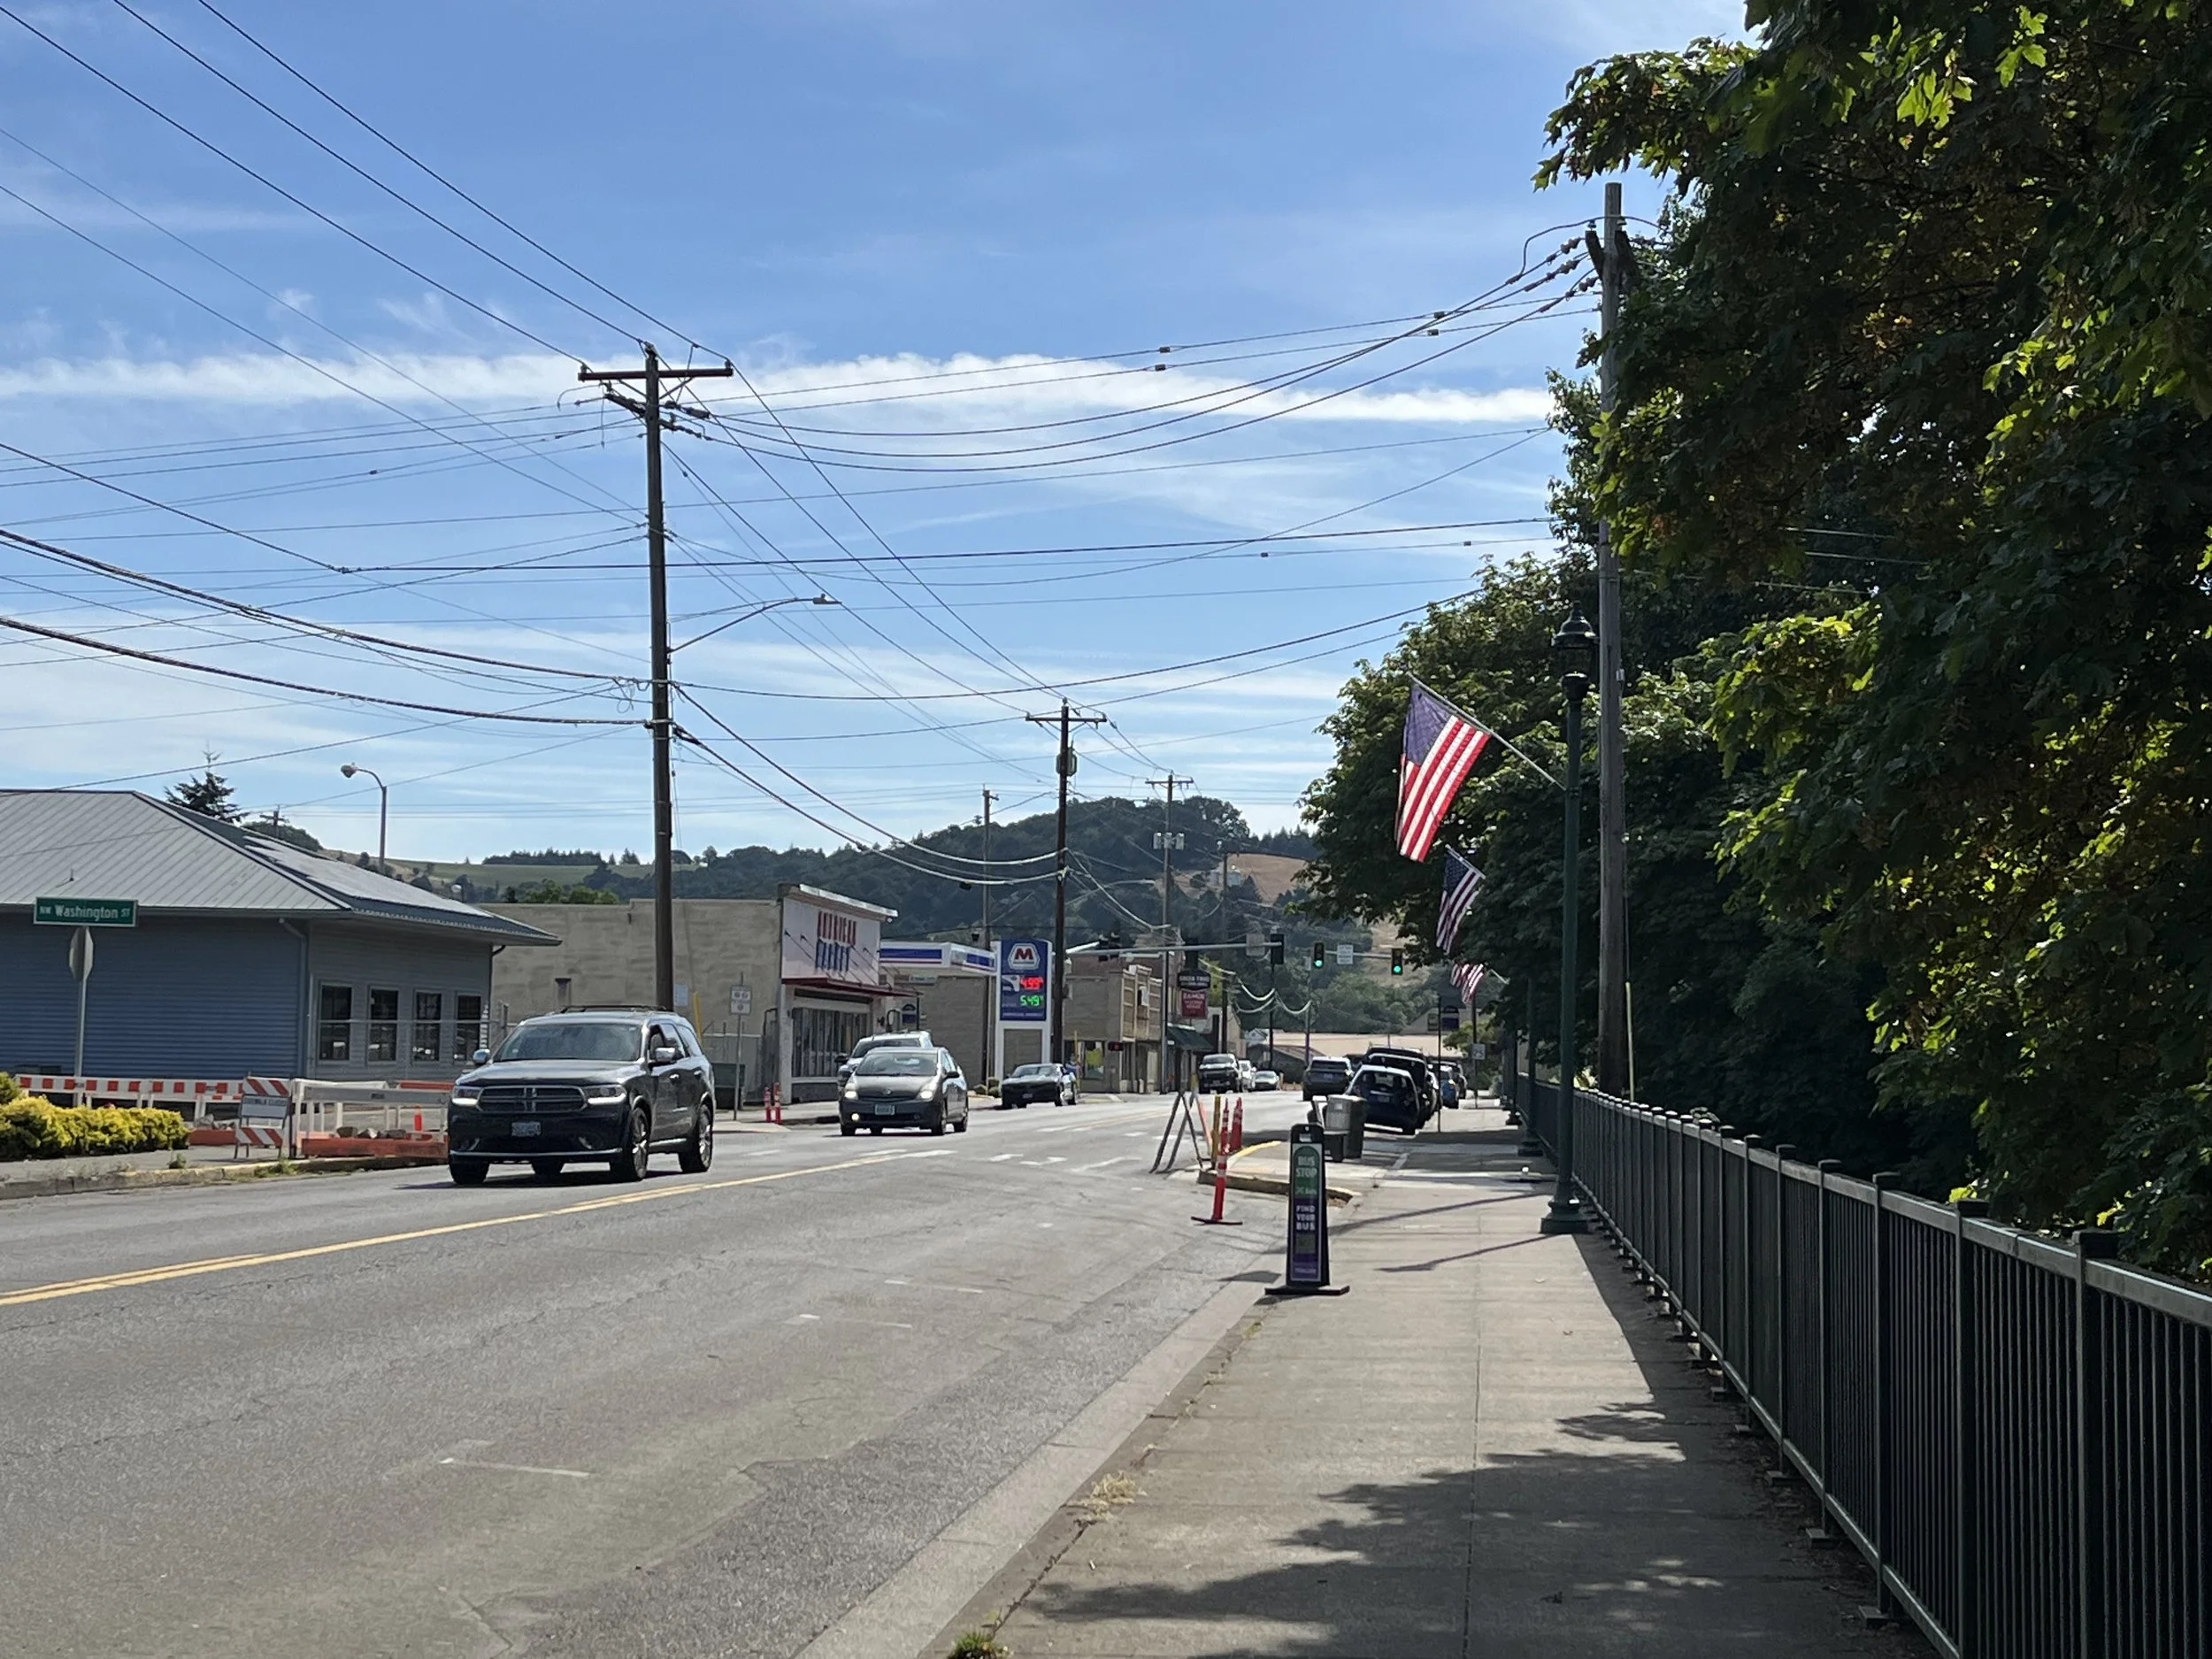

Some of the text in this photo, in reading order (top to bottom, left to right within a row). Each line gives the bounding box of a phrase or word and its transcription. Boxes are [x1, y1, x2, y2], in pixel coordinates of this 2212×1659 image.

[39, 905, 51, 915] NW
[54, 904, 119, 921] Washington
[1015, 948, 1033, 960] M
[1298, 1156, 1315, 1166] BUS
[1296, 1168, 1317, 1178] STOP
